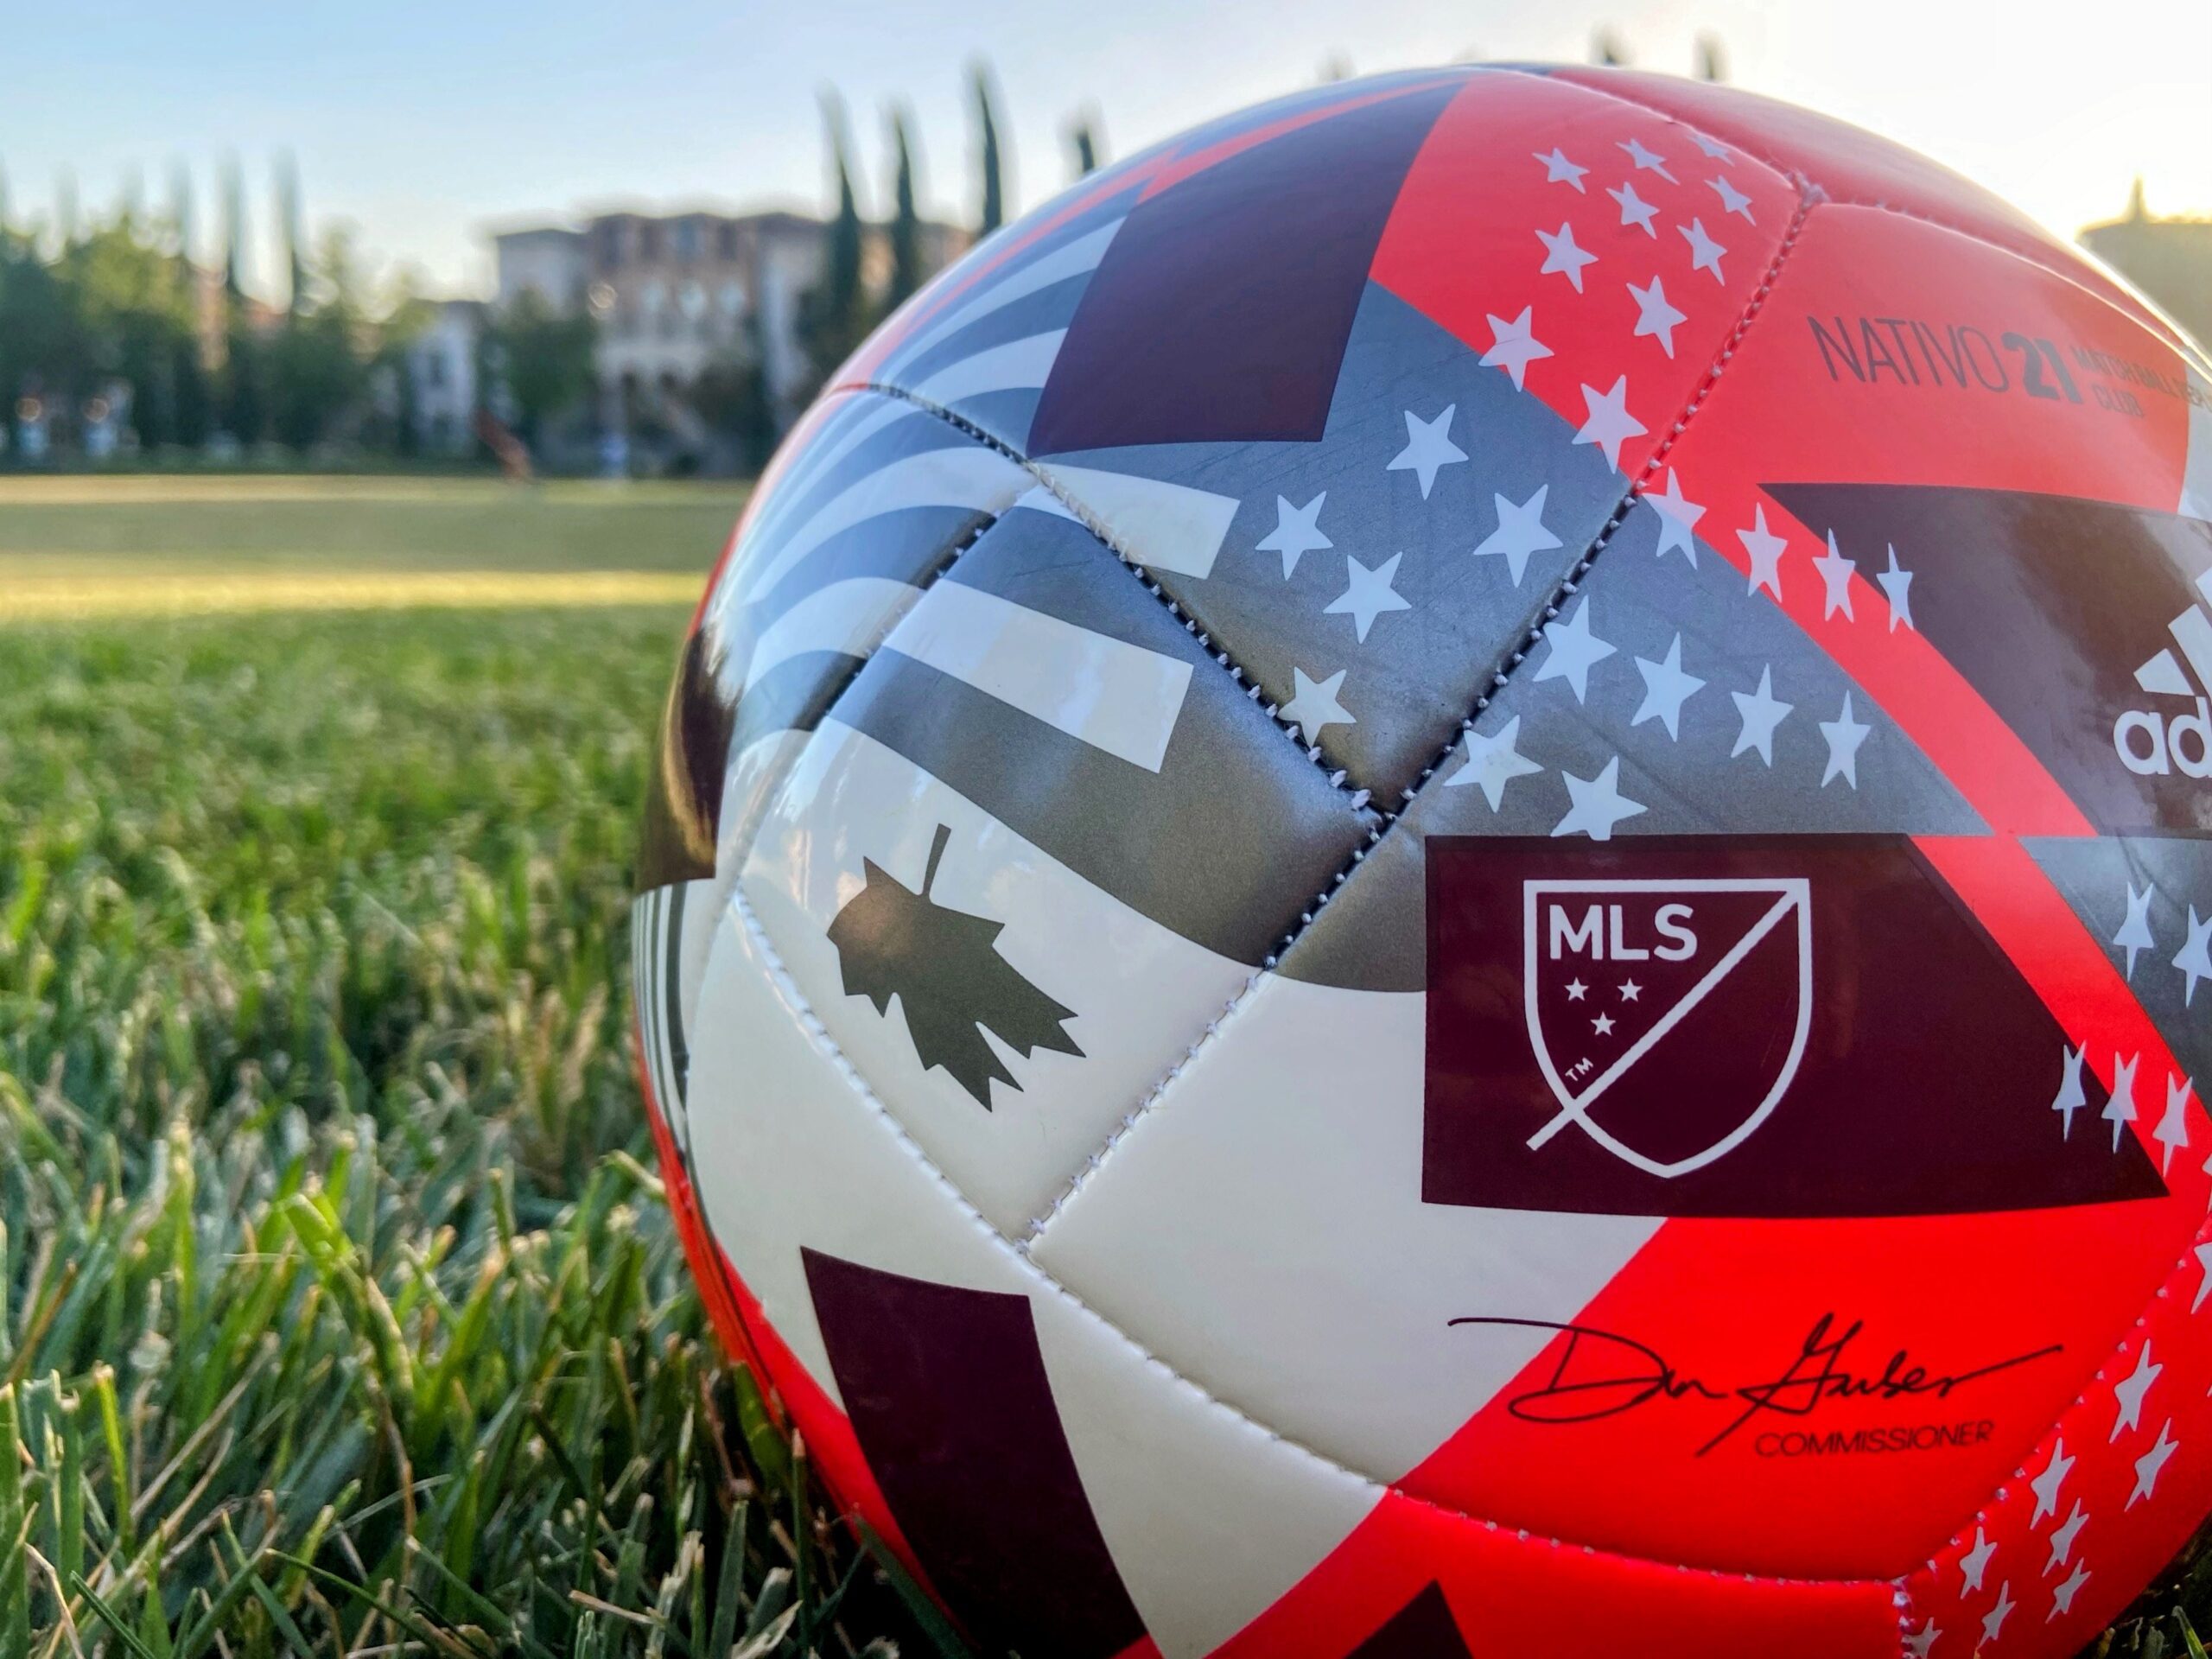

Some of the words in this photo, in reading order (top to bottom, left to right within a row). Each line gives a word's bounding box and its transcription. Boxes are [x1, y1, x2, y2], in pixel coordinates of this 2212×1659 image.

[1807, 315, 2011, 392] NATIVO
[2000, 332, 2083, 404] 21
[1549, 904, 1698, 961] MLS
[1755, 1420, 1994, 1458] COMMISSIONER
